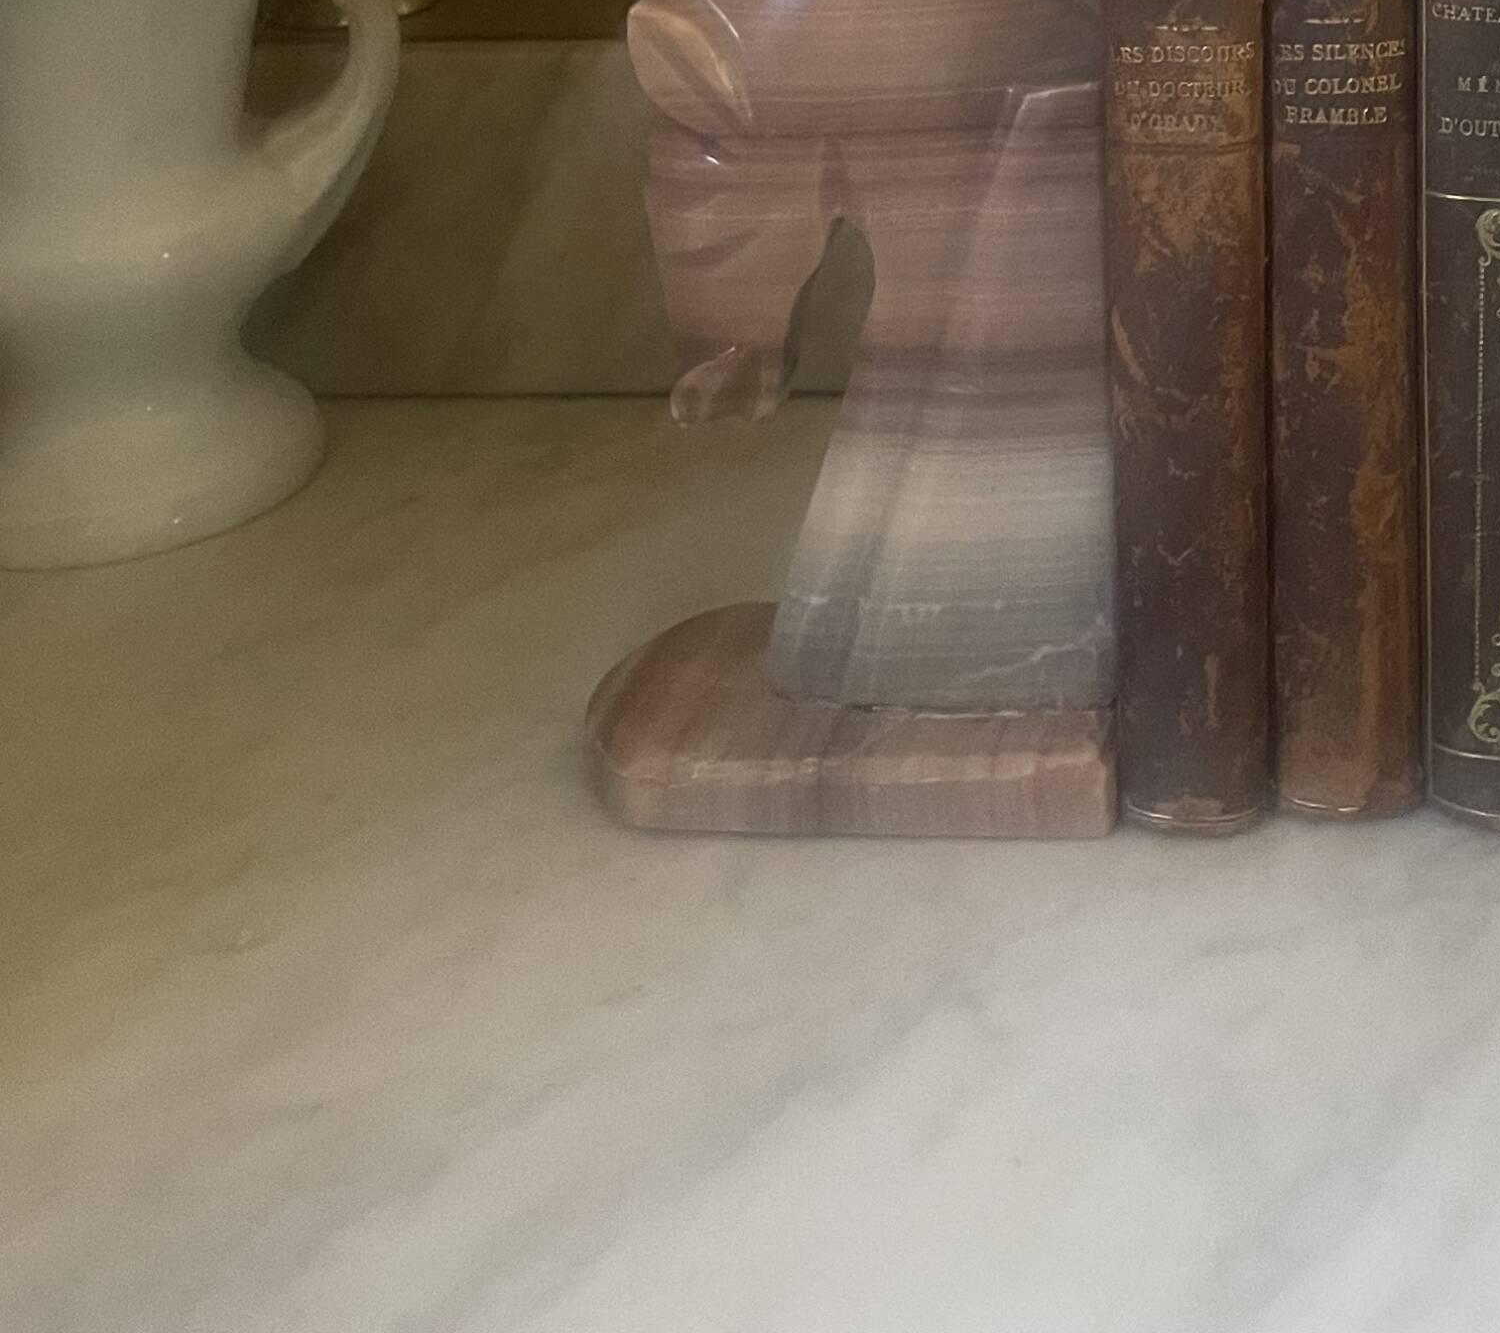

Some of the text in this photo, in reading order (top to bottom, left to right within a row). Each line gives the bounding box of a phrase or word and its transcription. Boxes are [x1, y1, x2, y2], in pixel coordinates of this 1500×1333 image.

[1151, 40, 1256, 64] DISCOURS
[1304, 72, 1403, 96] COLONEL
[1284, 104, 1389, 125] BRAMBLE
